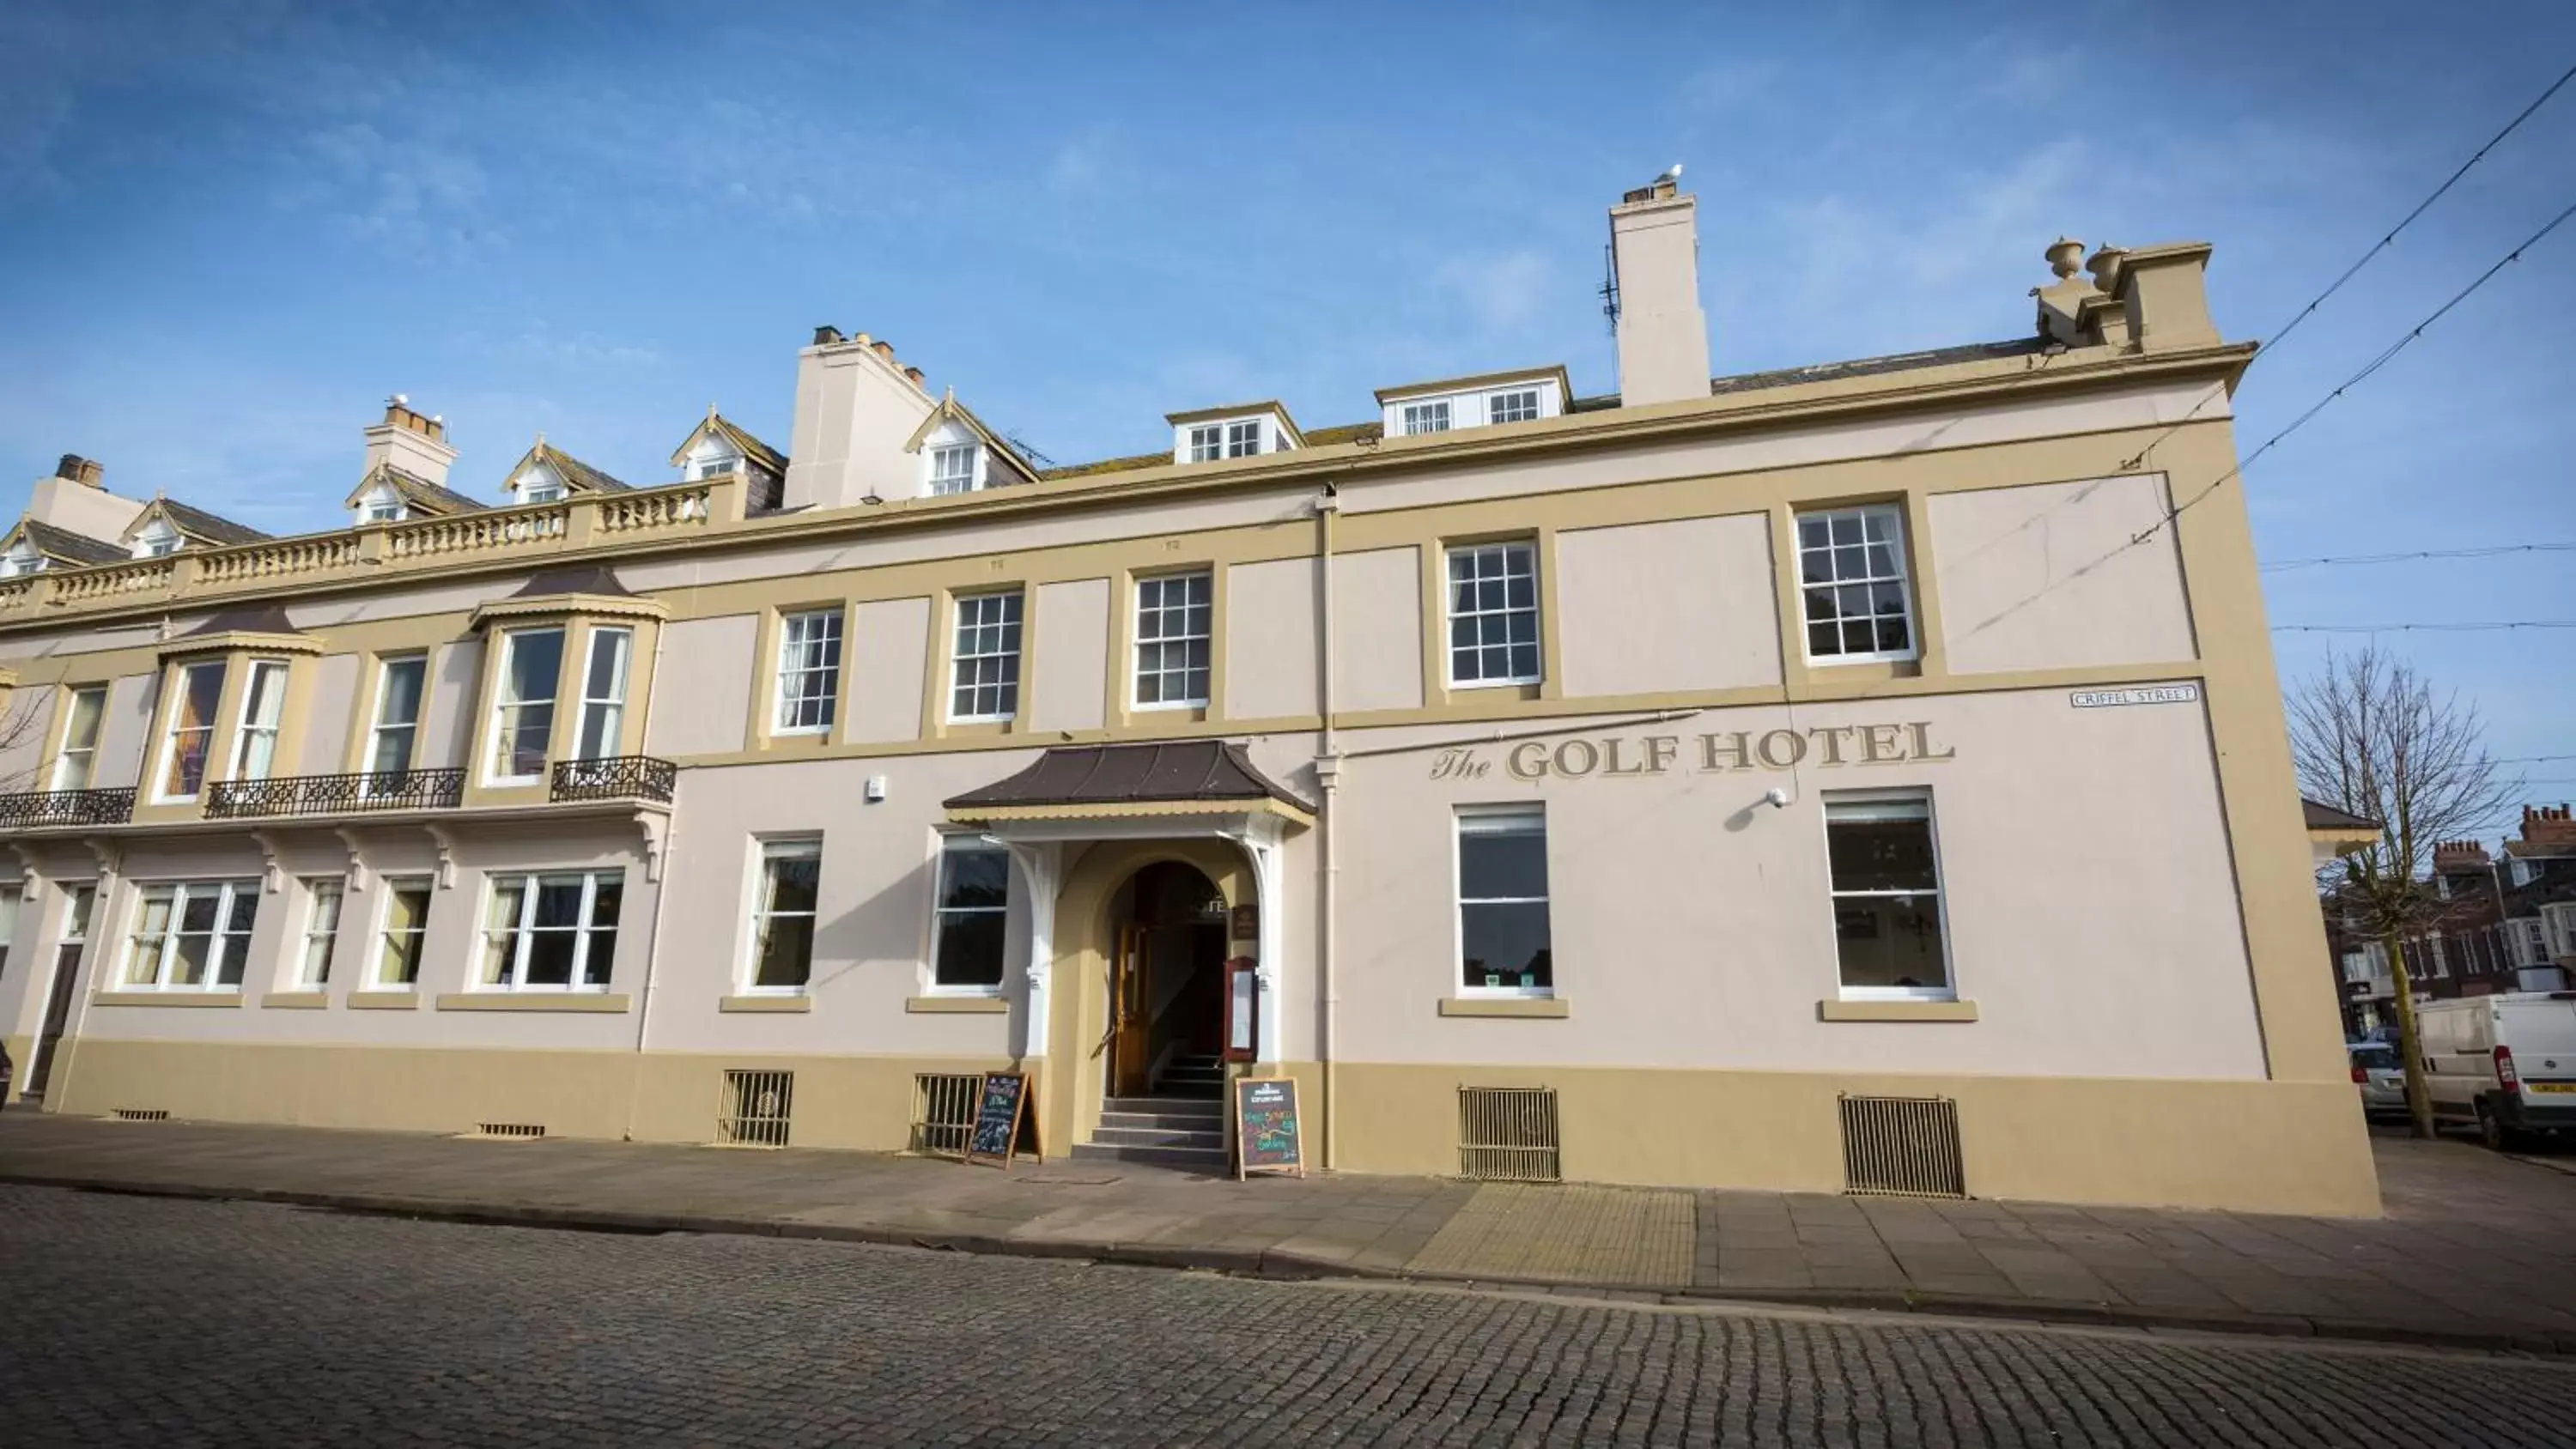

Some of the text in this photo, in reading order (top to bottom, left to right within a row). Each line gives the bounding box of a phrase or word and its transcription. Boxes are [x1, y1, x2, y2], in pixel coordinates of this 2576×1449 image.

[2137, 688, 2192, 701] STREET
[1430, 721, 1956, 783] The GOLF HOTEL
